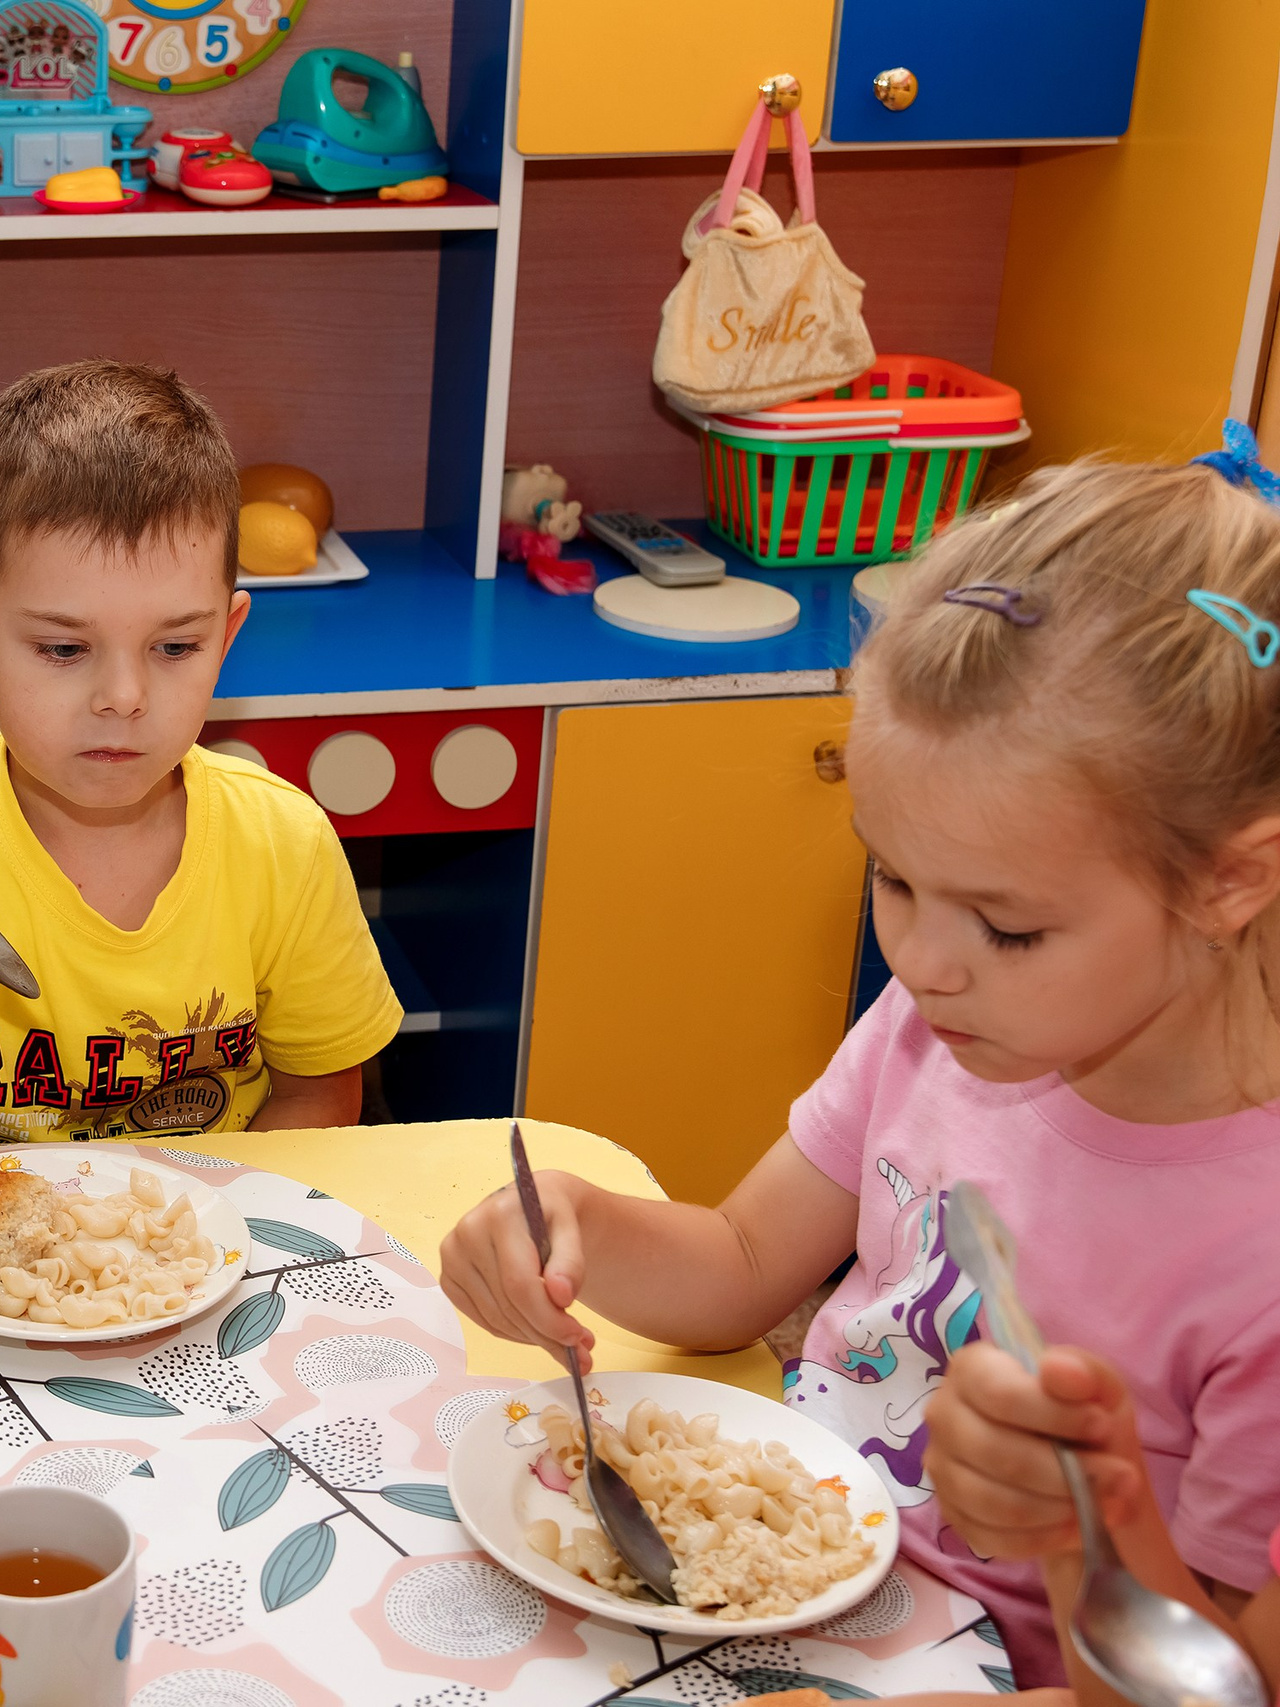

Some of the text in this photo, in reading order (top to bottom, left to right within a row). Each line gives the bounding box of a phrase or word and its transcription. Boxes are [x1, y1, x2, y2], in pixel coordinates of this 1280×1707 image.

[119, 22, 144, 61] 7
[156, 30, 182, 73] 6
[205, 25, 229, 63] 5
[707, 297, 817, 353] Smile
[208, 1020, 237, 1031] RACING
[136, 1087, 219, 1119] THE ROAD
[152, 1111, 205, 1128] SERVICE
